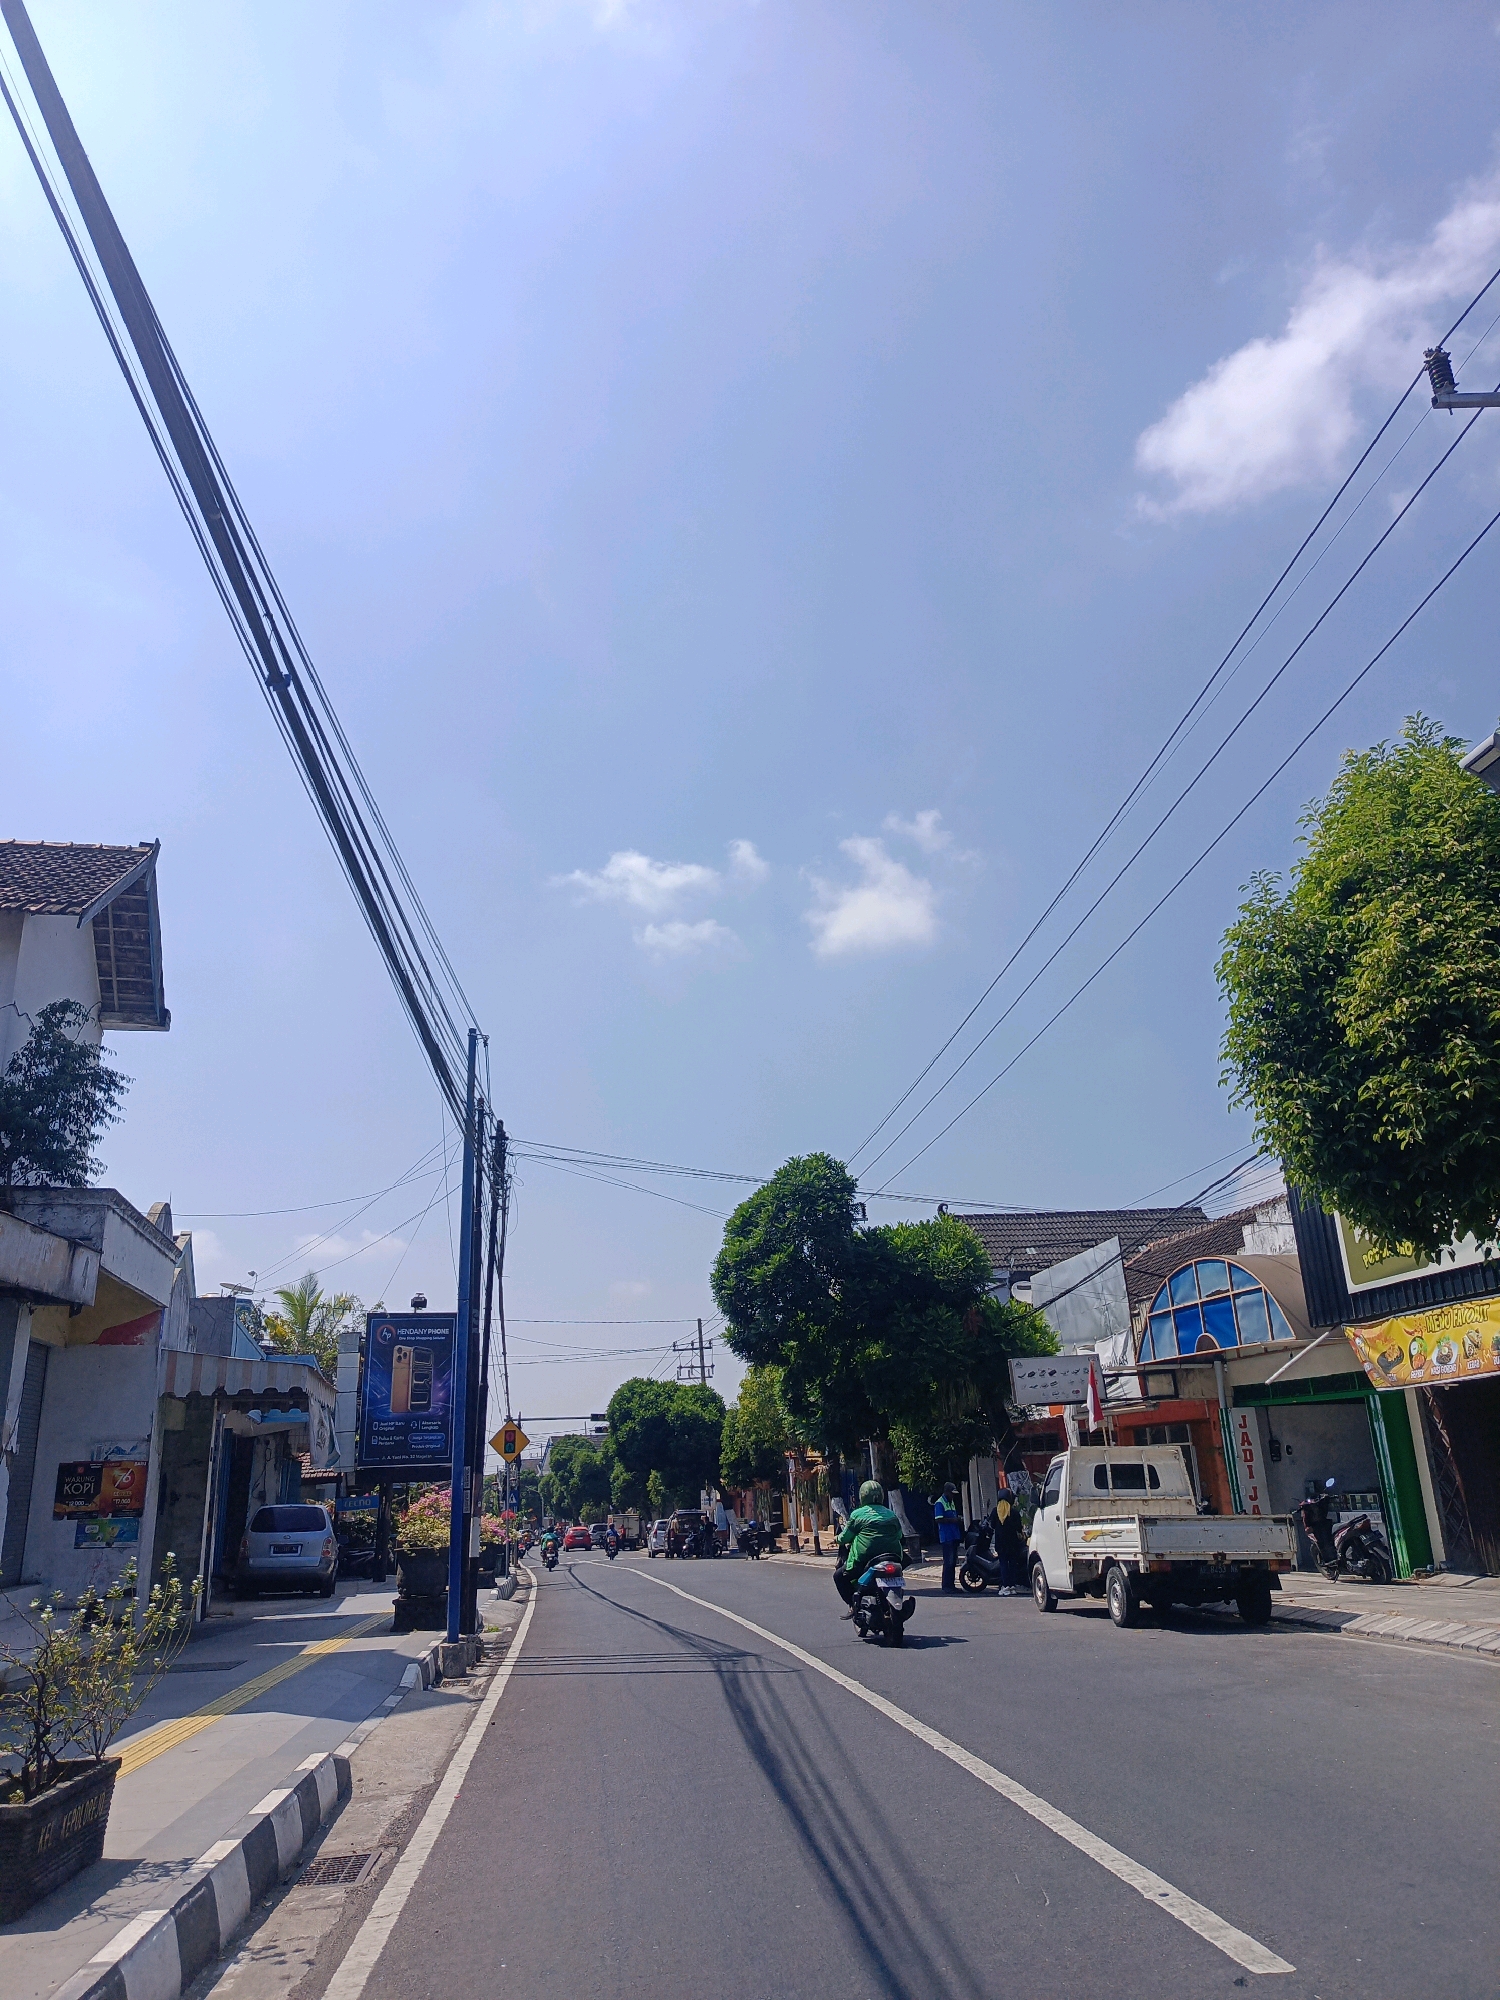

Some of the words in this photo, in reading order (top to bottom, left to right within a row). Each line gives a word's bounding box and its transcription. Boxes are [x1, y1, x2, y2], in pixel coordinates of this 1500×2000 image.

[1425, 1310, 1452, 1333] MENU
[1452, 1303, 1491, 1328] FAVORIT
[64, 1483, 94, 1494] KOPI
